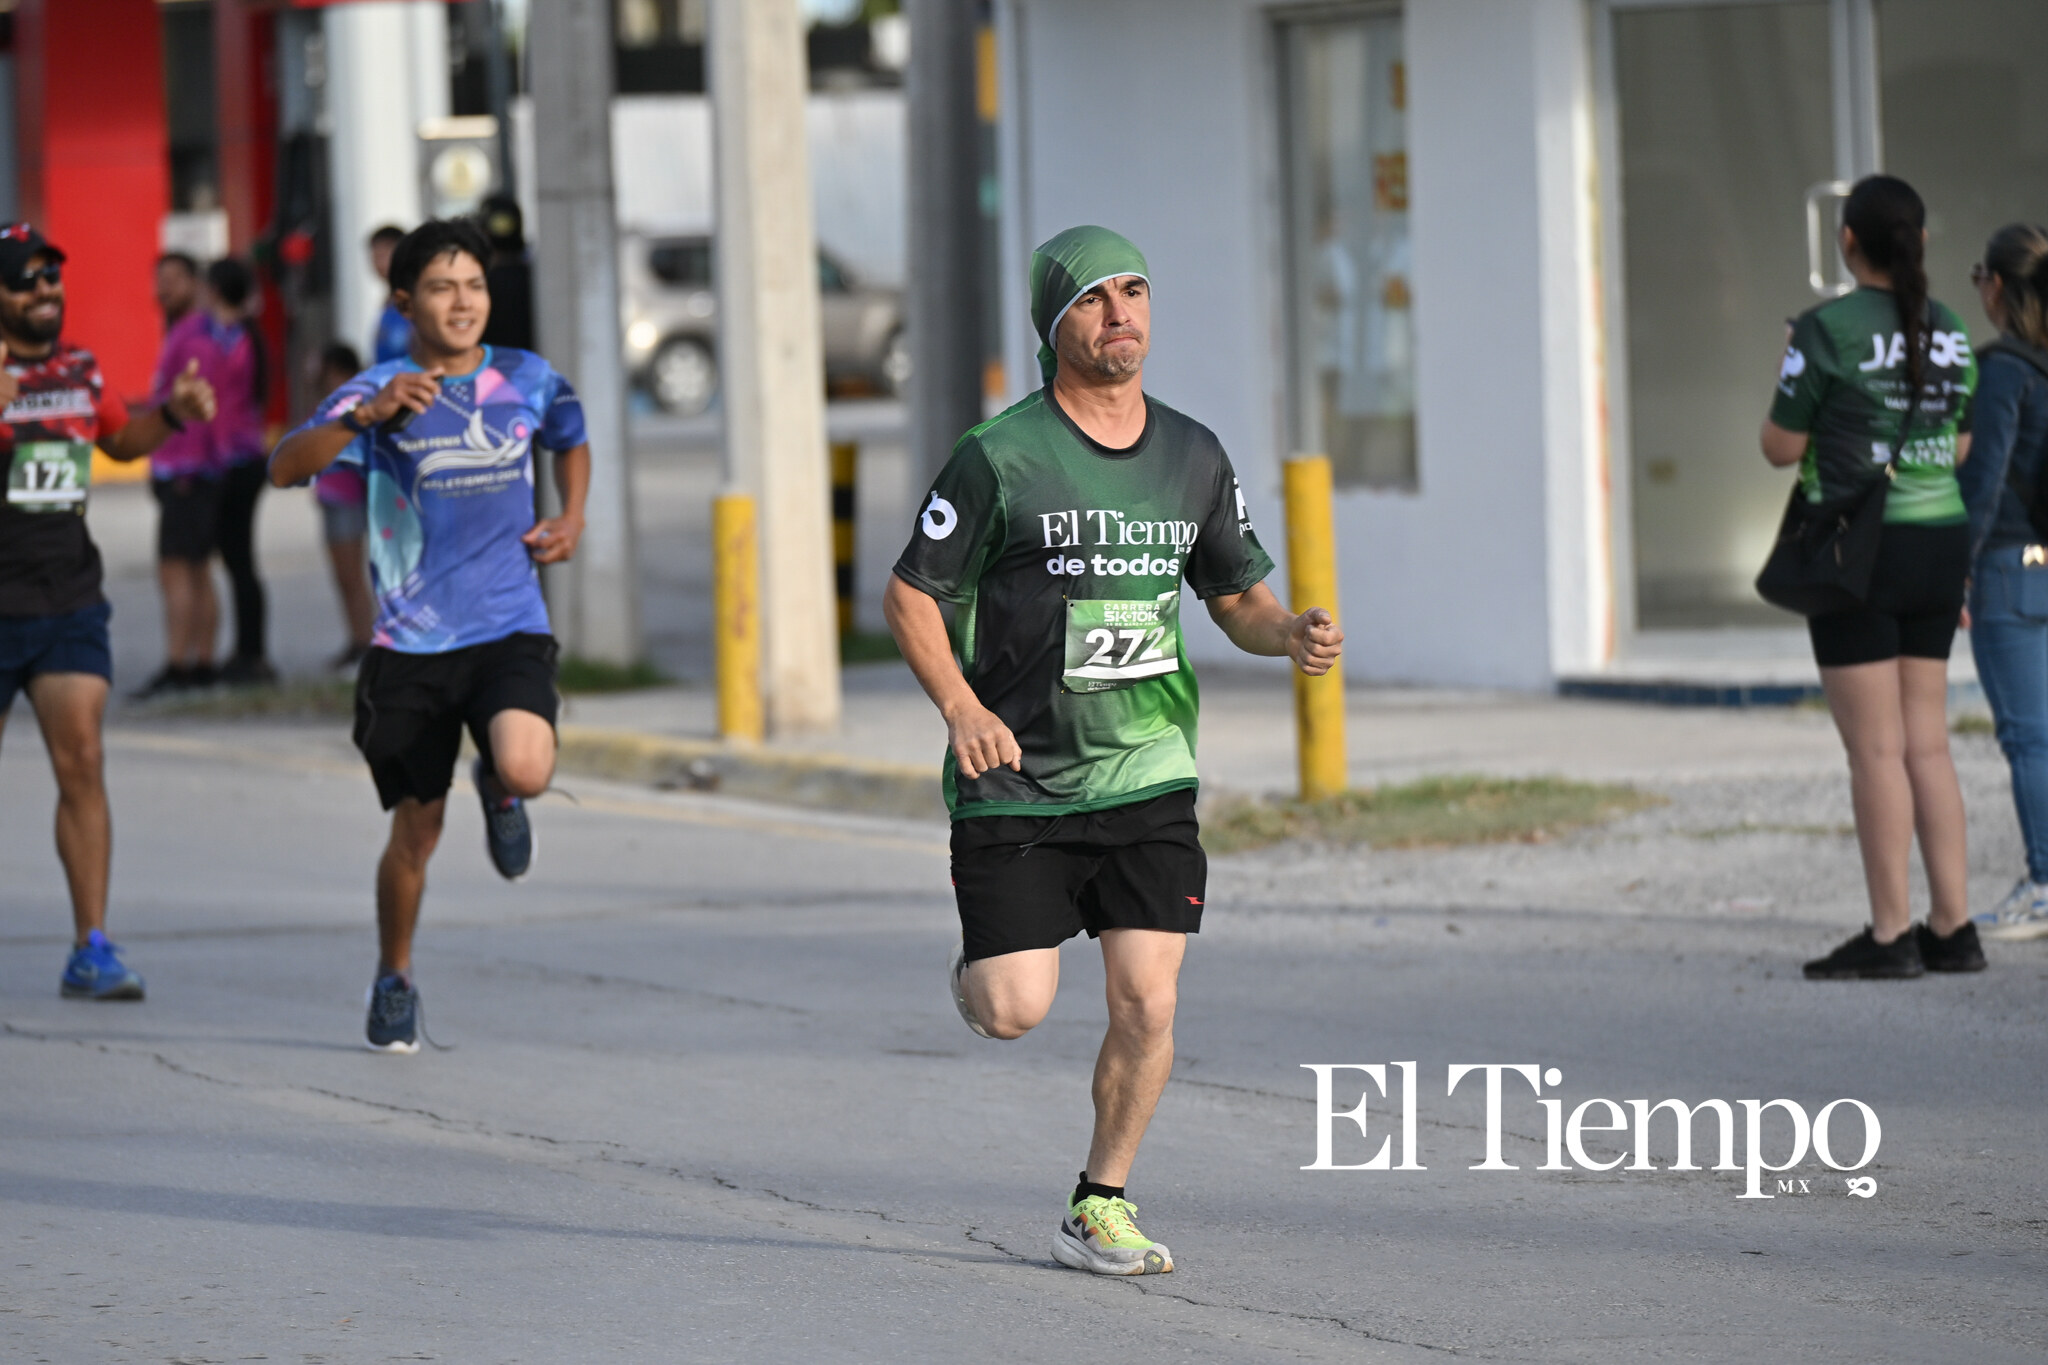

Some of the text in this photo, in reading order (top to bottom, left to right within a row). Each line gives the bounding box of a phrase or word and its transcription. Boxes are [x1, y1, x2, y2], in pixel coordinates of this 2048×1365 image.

[23, 460, 77, 490] 172
[1037, 509, 1199, 555] El Tiempo
[1046, 553, 1180, 577] de todos
[1103, 603, 1161, 611] CARRERA
[1084, 626, 1165, 666] 272
